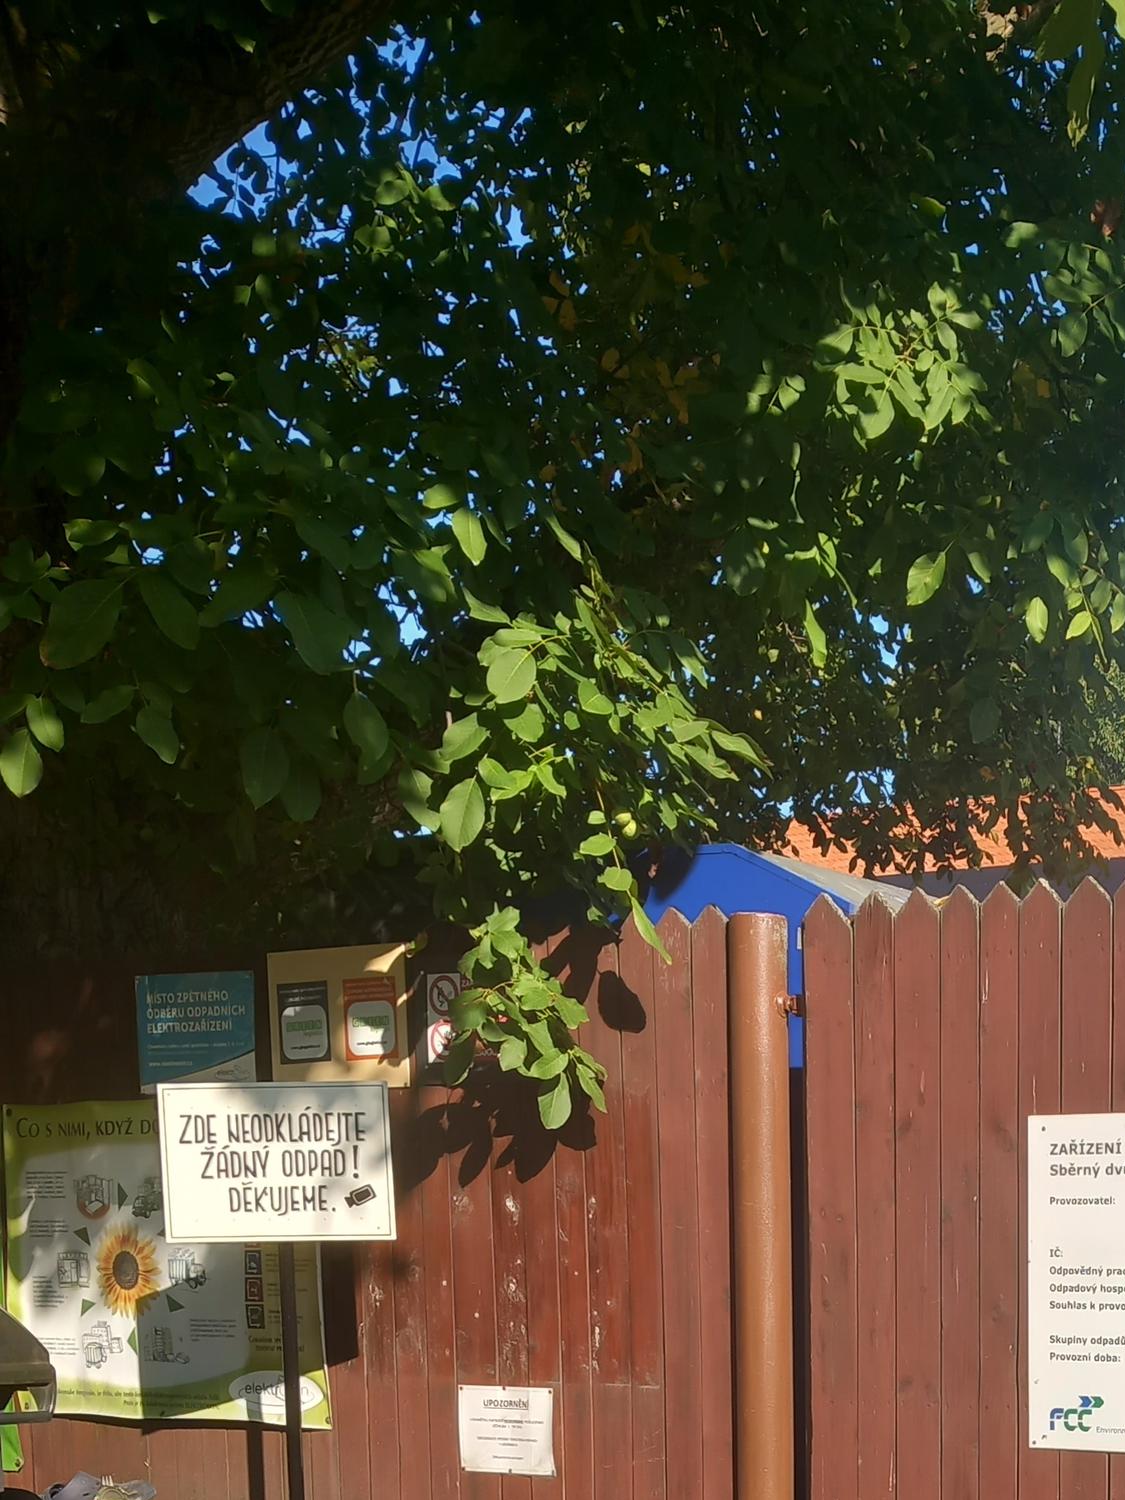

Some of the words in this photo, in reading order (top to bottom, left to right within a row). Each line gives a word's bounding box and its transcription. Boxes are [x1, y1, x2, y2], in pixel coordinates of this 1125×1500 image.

[187, 1004, 245, 1018] ODPADNÍCH
[148, 1019, 232, 1034] ELEKTROZAŘÍZENÍ
[179, 1114, 217, 1144] ZDE
[227, 1106, 366, 1146] NEODKLÁDEJTE
[1050, 1138, 1122, 1155] ZAŘÍZENÍ
[200, 1145, 270, 1179] ŽÁDNÝ
[1050, 1162, 1100, 1178] Sběrný
[228, 1182, 336, 1216] DĚKUJEME.
[1050, 1196, 1115, 1205] Provozovatel:
[1050, 1247, 1064, 1258] IČ:
[1050, 1266, 1103, 1277] Odpovědný
[1050, 1283, 1097, 1294] Odpadový
[1050, 1300, 1088, 1310] Souhlas
[1090, 1301, 1096, 1310] k
[1050, 1335, 1088, 1347] Skupiny
[1050, 1352, 1092, 1362] Provozní
[1094, 1353, 1121, 1363] doba:
[1050, 1408, 1092, 1432] FCC
